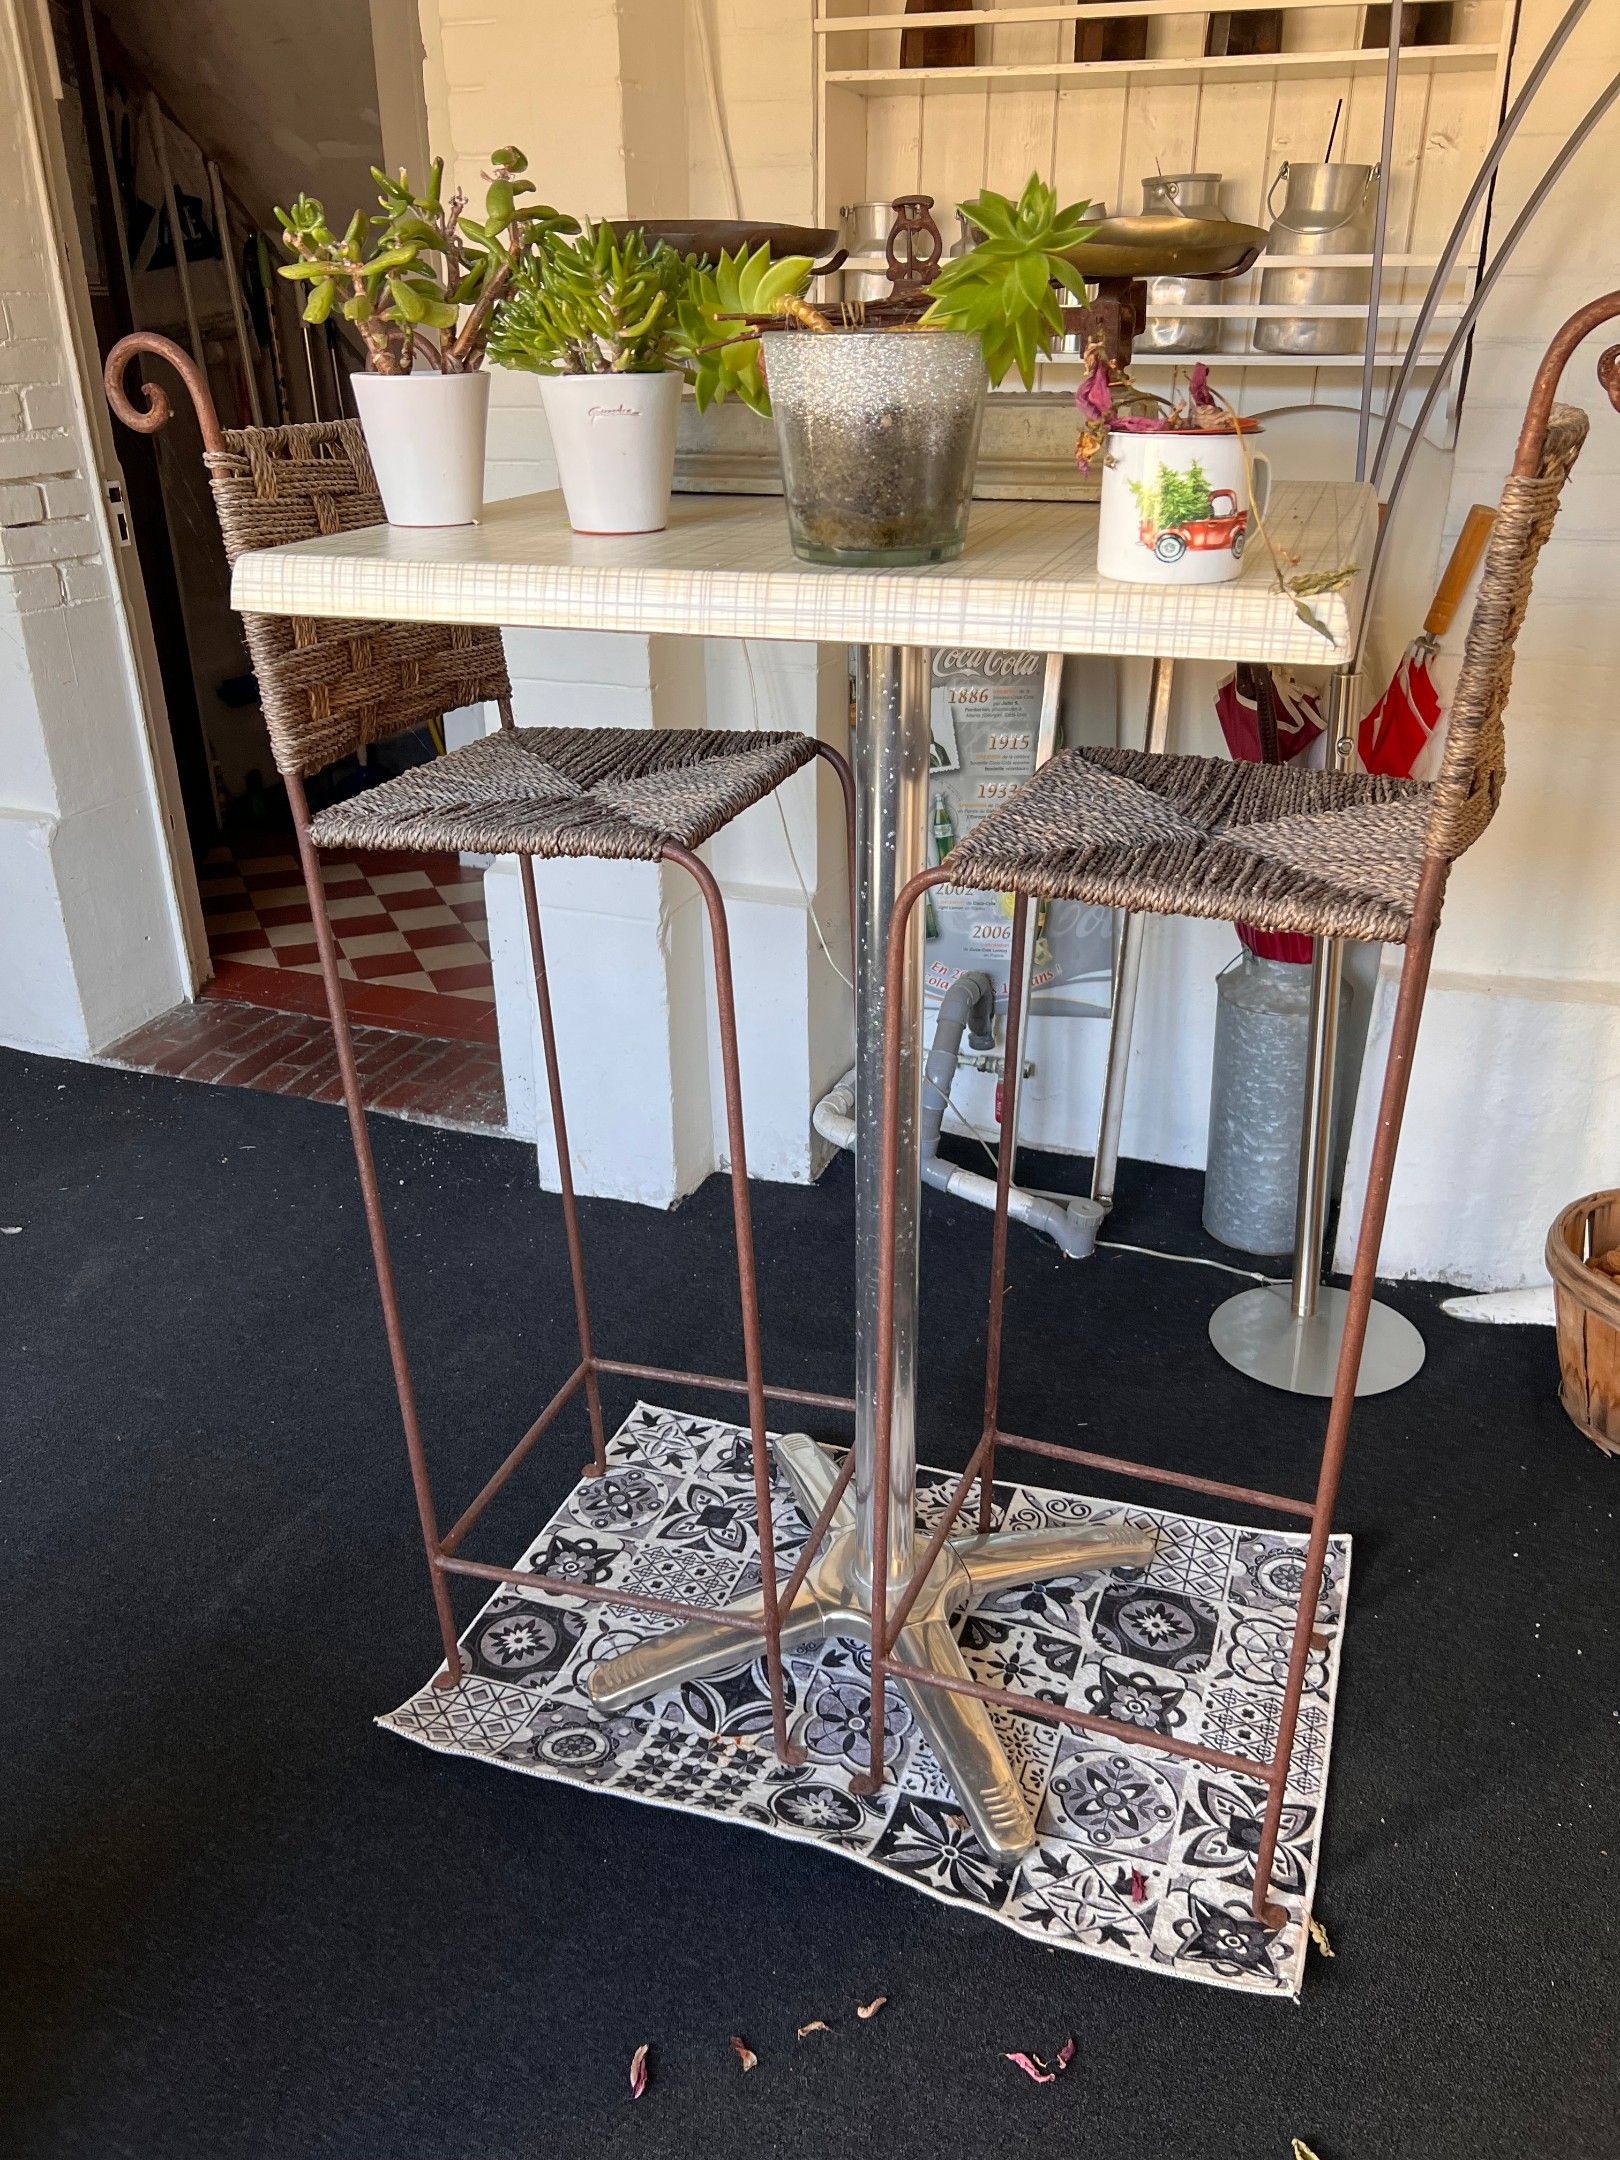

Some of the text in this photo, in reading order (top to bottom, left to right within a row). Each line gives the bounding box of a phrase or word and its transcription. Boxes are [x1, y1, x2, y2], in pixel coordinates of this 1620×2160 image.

[948, 687, 989, 703] 1886
[988, 735, 1030, 750] 1915
[973, 925, 1011, 939] 2006
[931, 961, 948, 976] En
